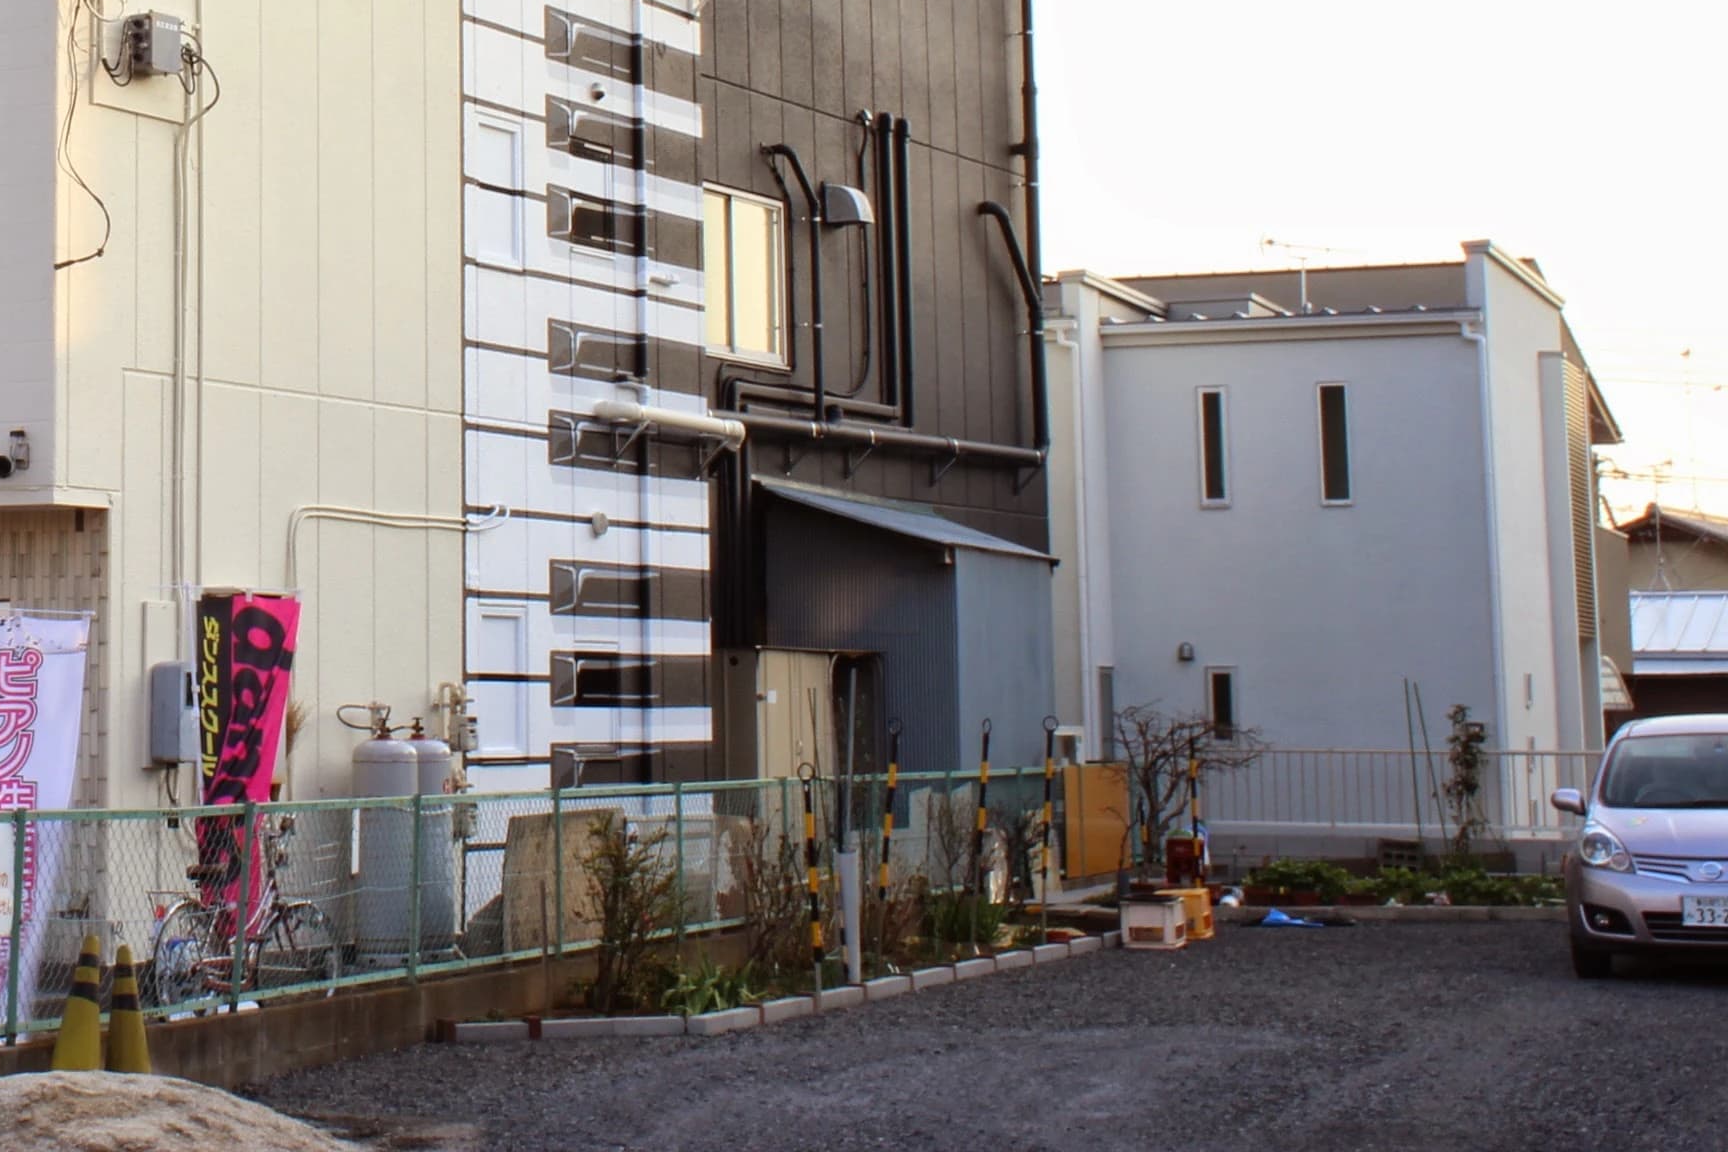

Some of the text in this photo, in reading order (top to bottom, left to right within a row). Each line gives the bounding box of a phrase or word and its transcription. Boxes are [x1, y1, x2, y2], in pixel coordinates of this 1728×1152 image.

[199, 615, 221, 778] ダンススクール
